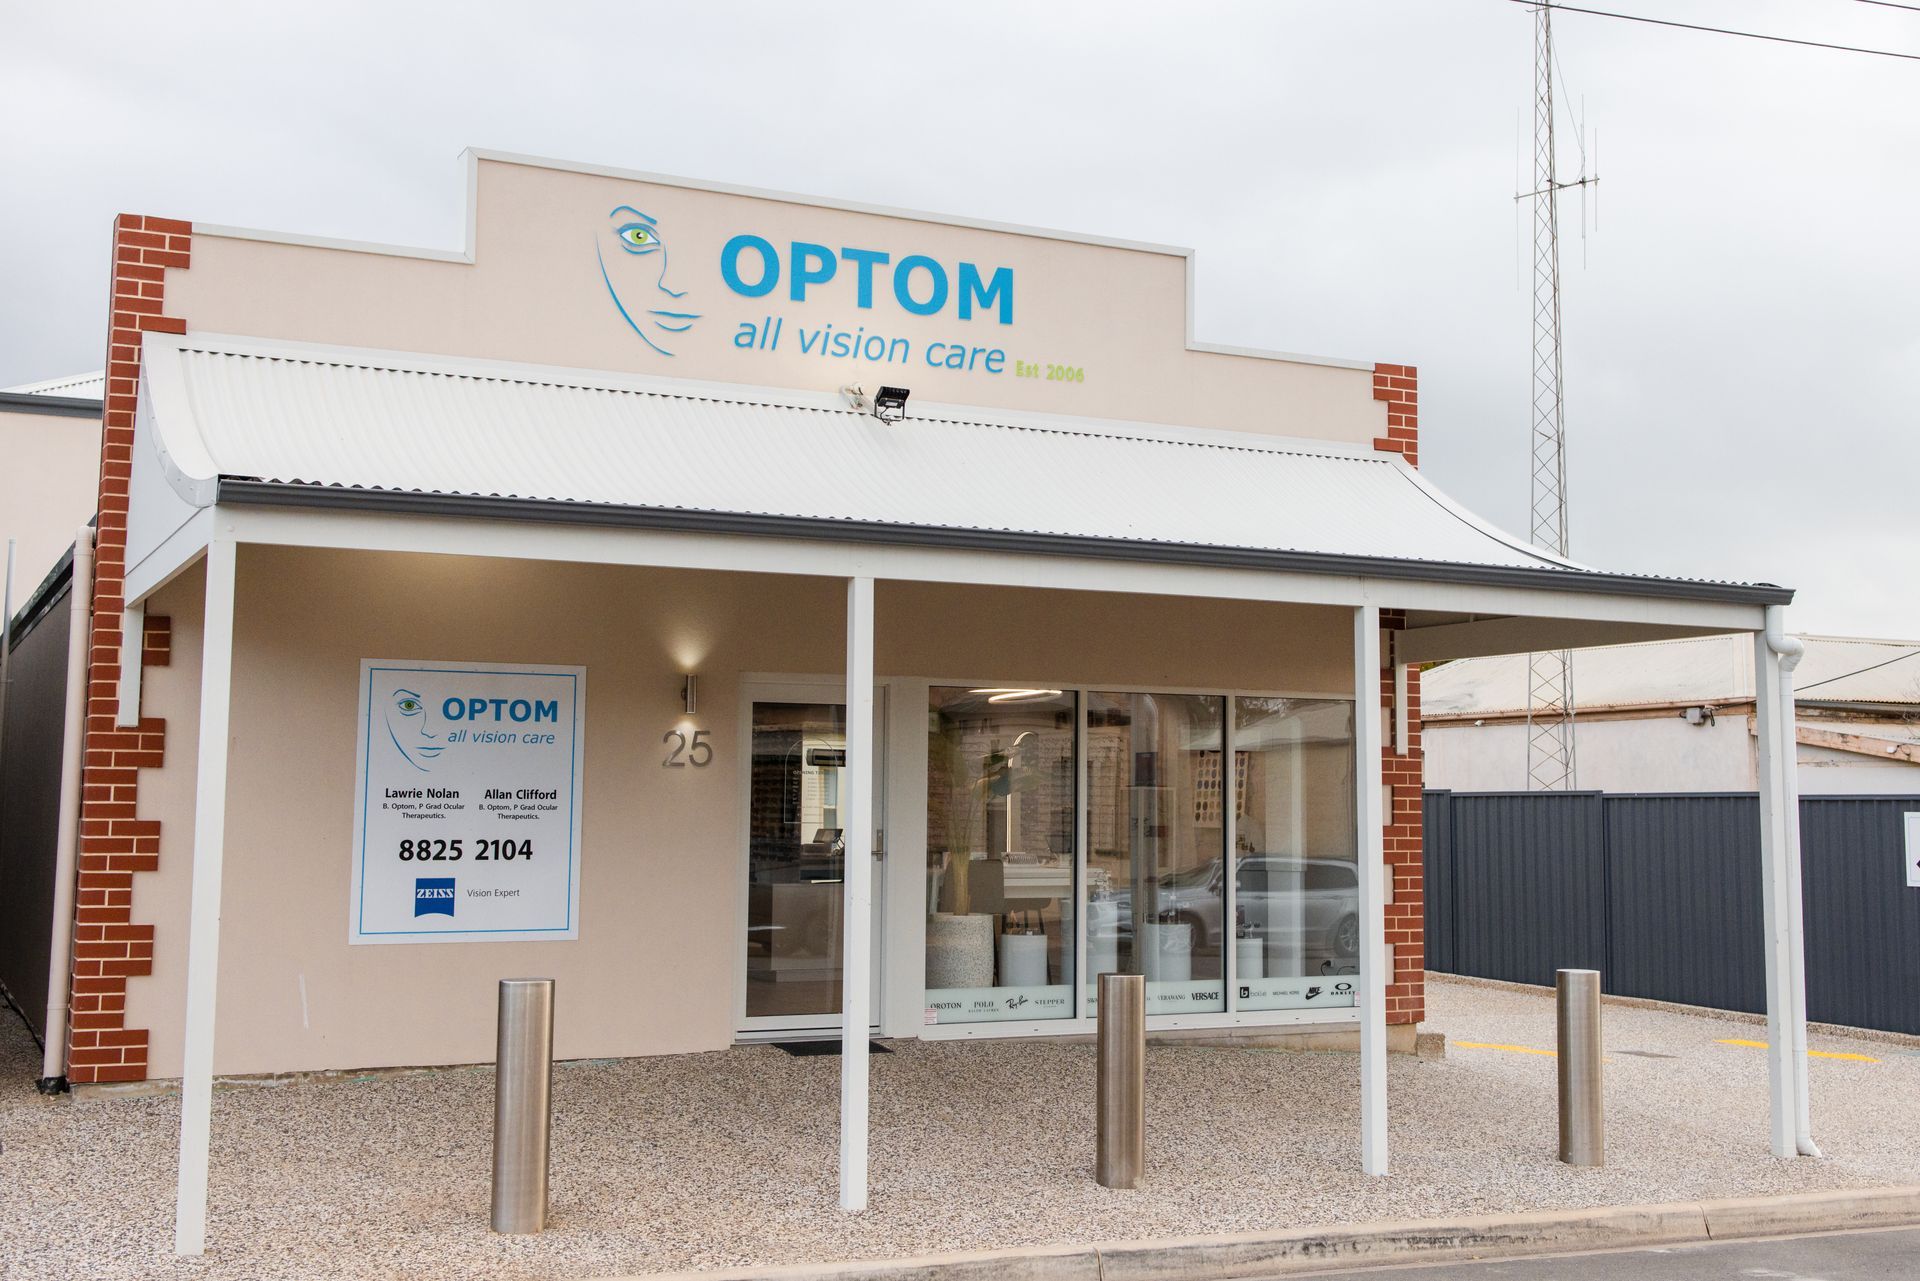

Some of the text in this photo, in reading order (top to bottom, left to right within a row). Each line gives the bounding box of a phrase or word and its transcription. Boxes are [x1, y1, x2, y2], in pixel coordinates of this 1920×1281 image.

[720, 234, 1014, 325] OPTOM
[733, 316, 1006, 374] all vision care
[1015, 360, 1085, 382] Est 2006
[442, 697, 559, 722] OPTOM
[447, 730, 556, 745] all vision care
[662, 730, 713, 767] 25
[385, 788, 460, 799] Lawrie Nolan
[484, 789, 557, 800] Allan Clifford
[391, 803, 417, 811] Optom,
[487, 804, 512, 812] Optom,
[402, 812, 446, 820] Therapeutics.
[497, 813, 540, 821] Therapeutics.
[398, 839, 533, 861] 8825 2104
[416, 888, 454, 898] ZEISS
[467, 889, 520, 899] Vision Expert
[1191, 992, 1219, 1000] VERSACE
[930, 1002, 962, 1010] OROTON
